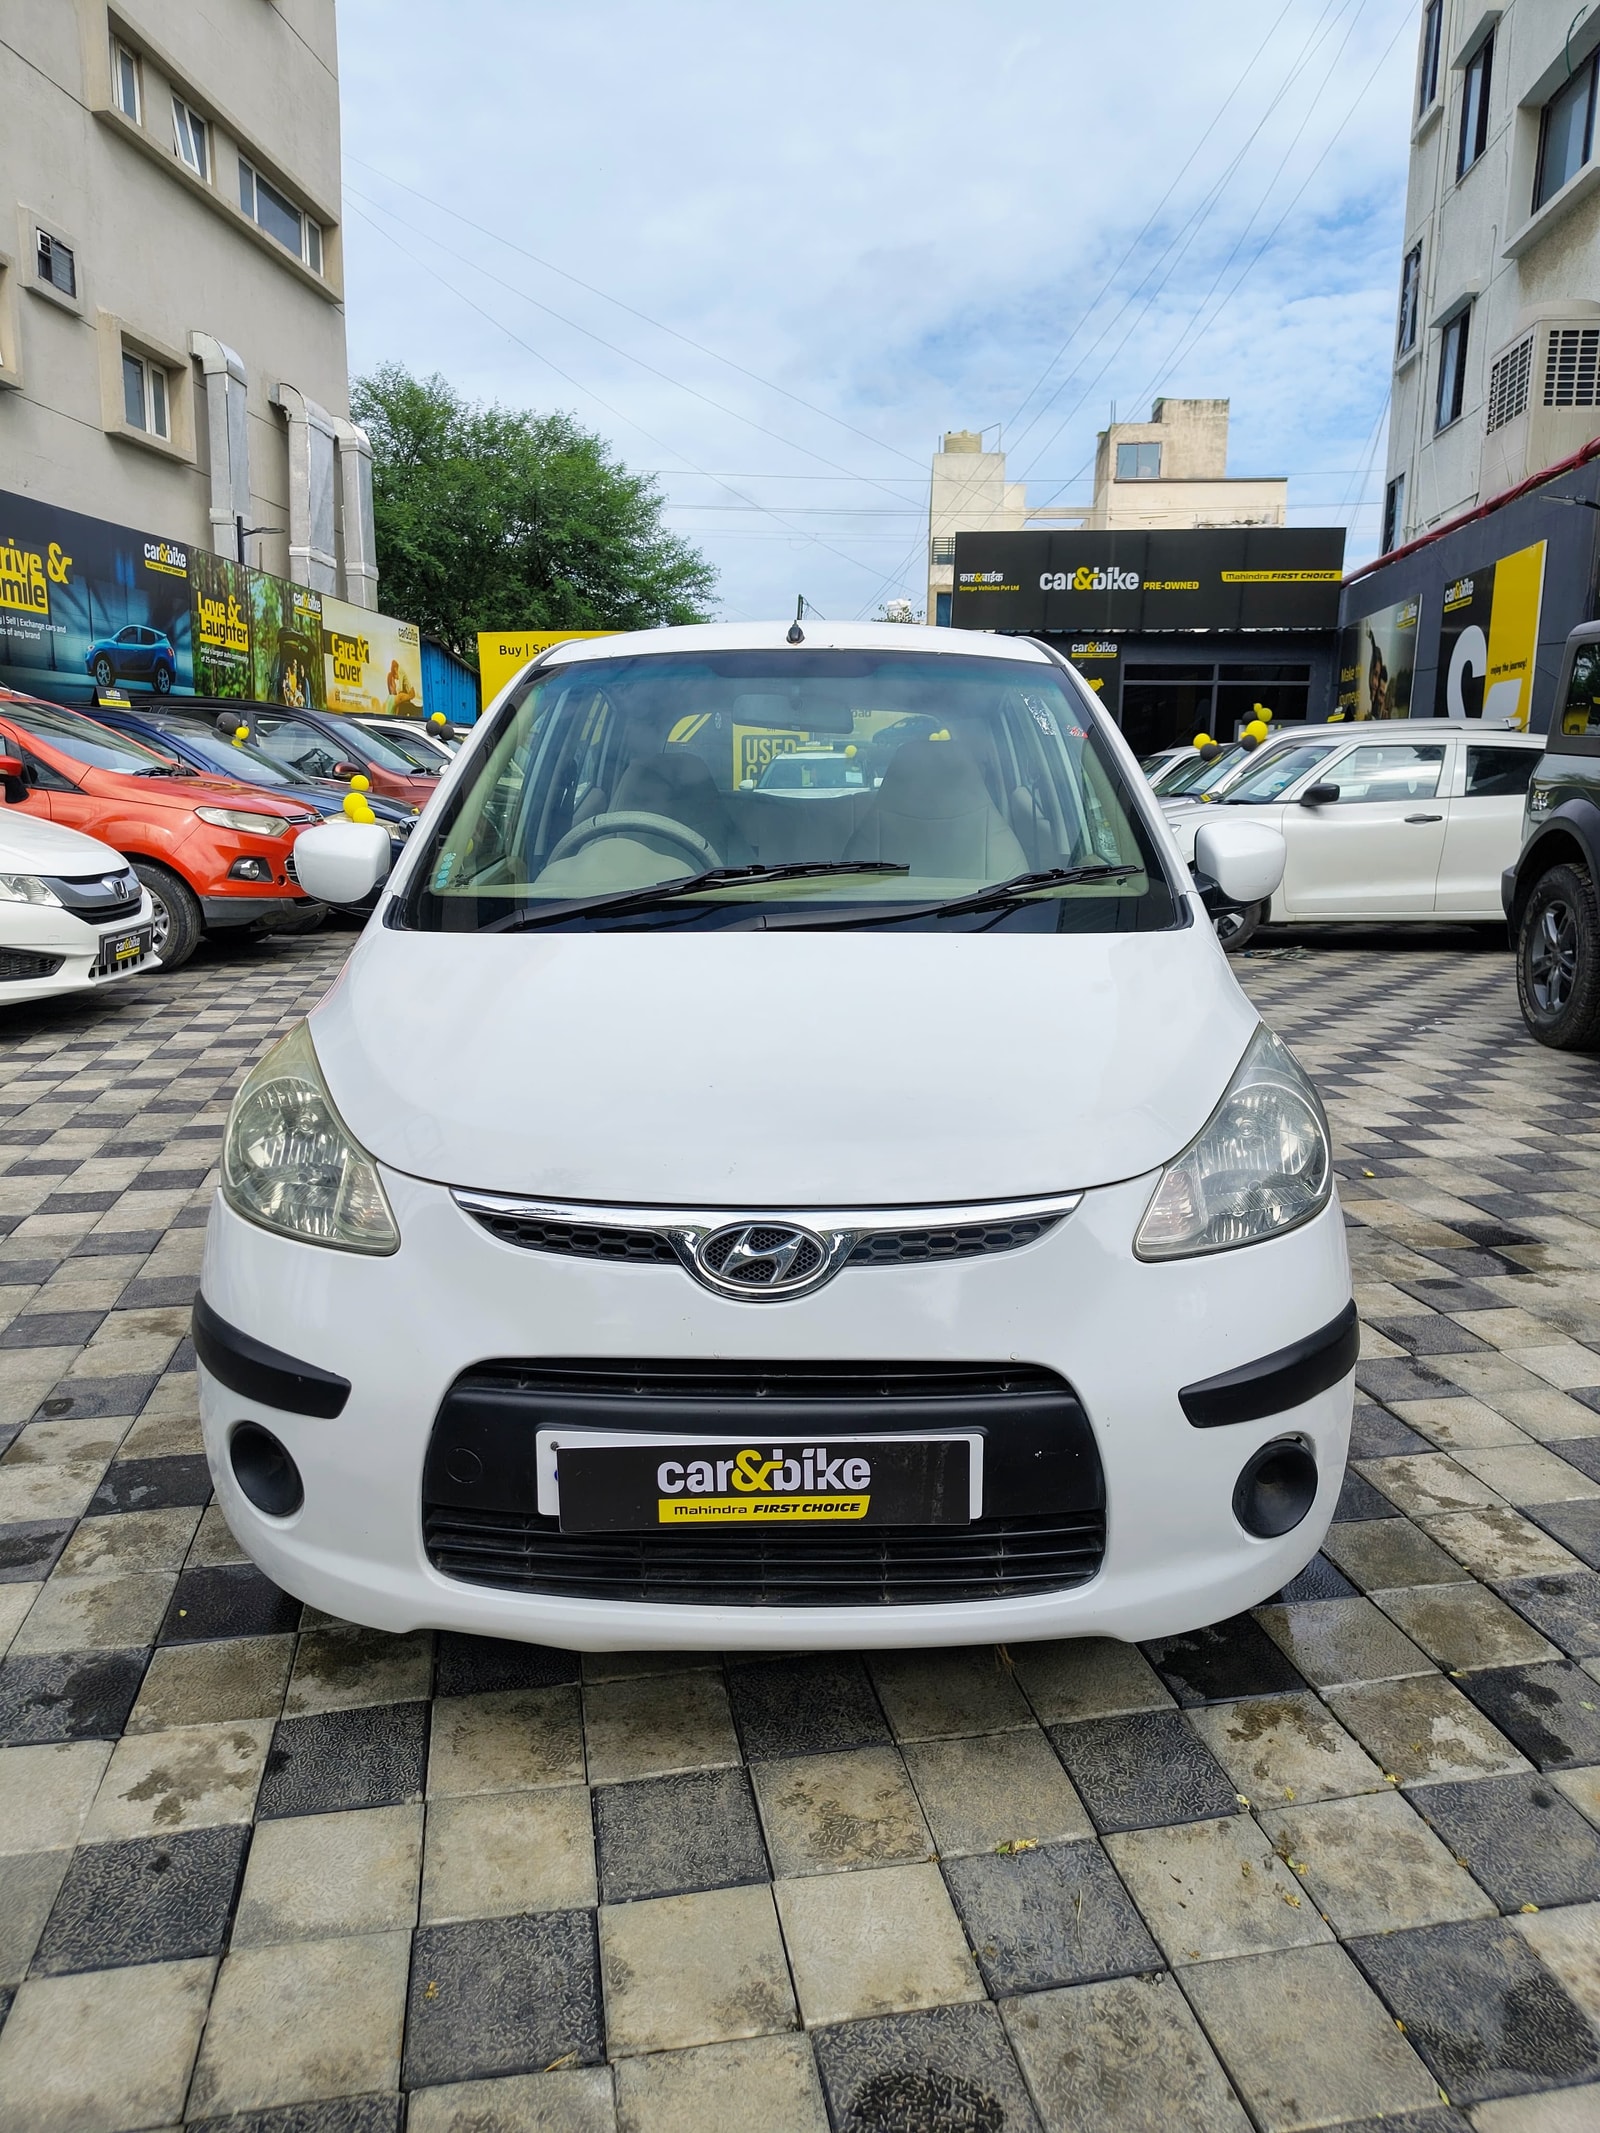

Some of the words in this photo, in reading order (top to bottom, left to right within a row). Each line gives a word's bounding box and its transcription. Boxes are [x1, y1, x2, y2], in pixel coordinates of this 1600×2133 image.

[48, 542, 73, 584] &
[144, 542, 187, 568] car&bike
[1039, 566, 1140, 591] car&bike
[1143, 581, 1200, 590] PRE-OWNED
[1225, 573, 1270, 581] Mahindra
[1271, 572, 1299, 580] FIRST
[1300, 572, 1336, 580] CHOICE
[0, 573, 46, 609] mile
[293, 592, 322, 613] car&bike
[1444, 577, 1474, 604] car&bike
[197, 591, 226, 618] Love
[227, 594, 242, 624] &
[20, 618, 45, 631] Exchange
[200, 613, 248, 645] Laughter
[331, 633, 356, 662] Care
[499, 644, 522, 658] Buy
[1071, 641, 1118, 653] car&bike
[333, 657, 362, 683] Cover
[115, 935, 141, 952] car&bike
[656, 1447, 871, 1494] car&bike
[673, 1505, 748, 1516] Mahindra
[752, 1502, 801, 1514] FIRST
[801, 1502, 861, 1513] CHOICE
